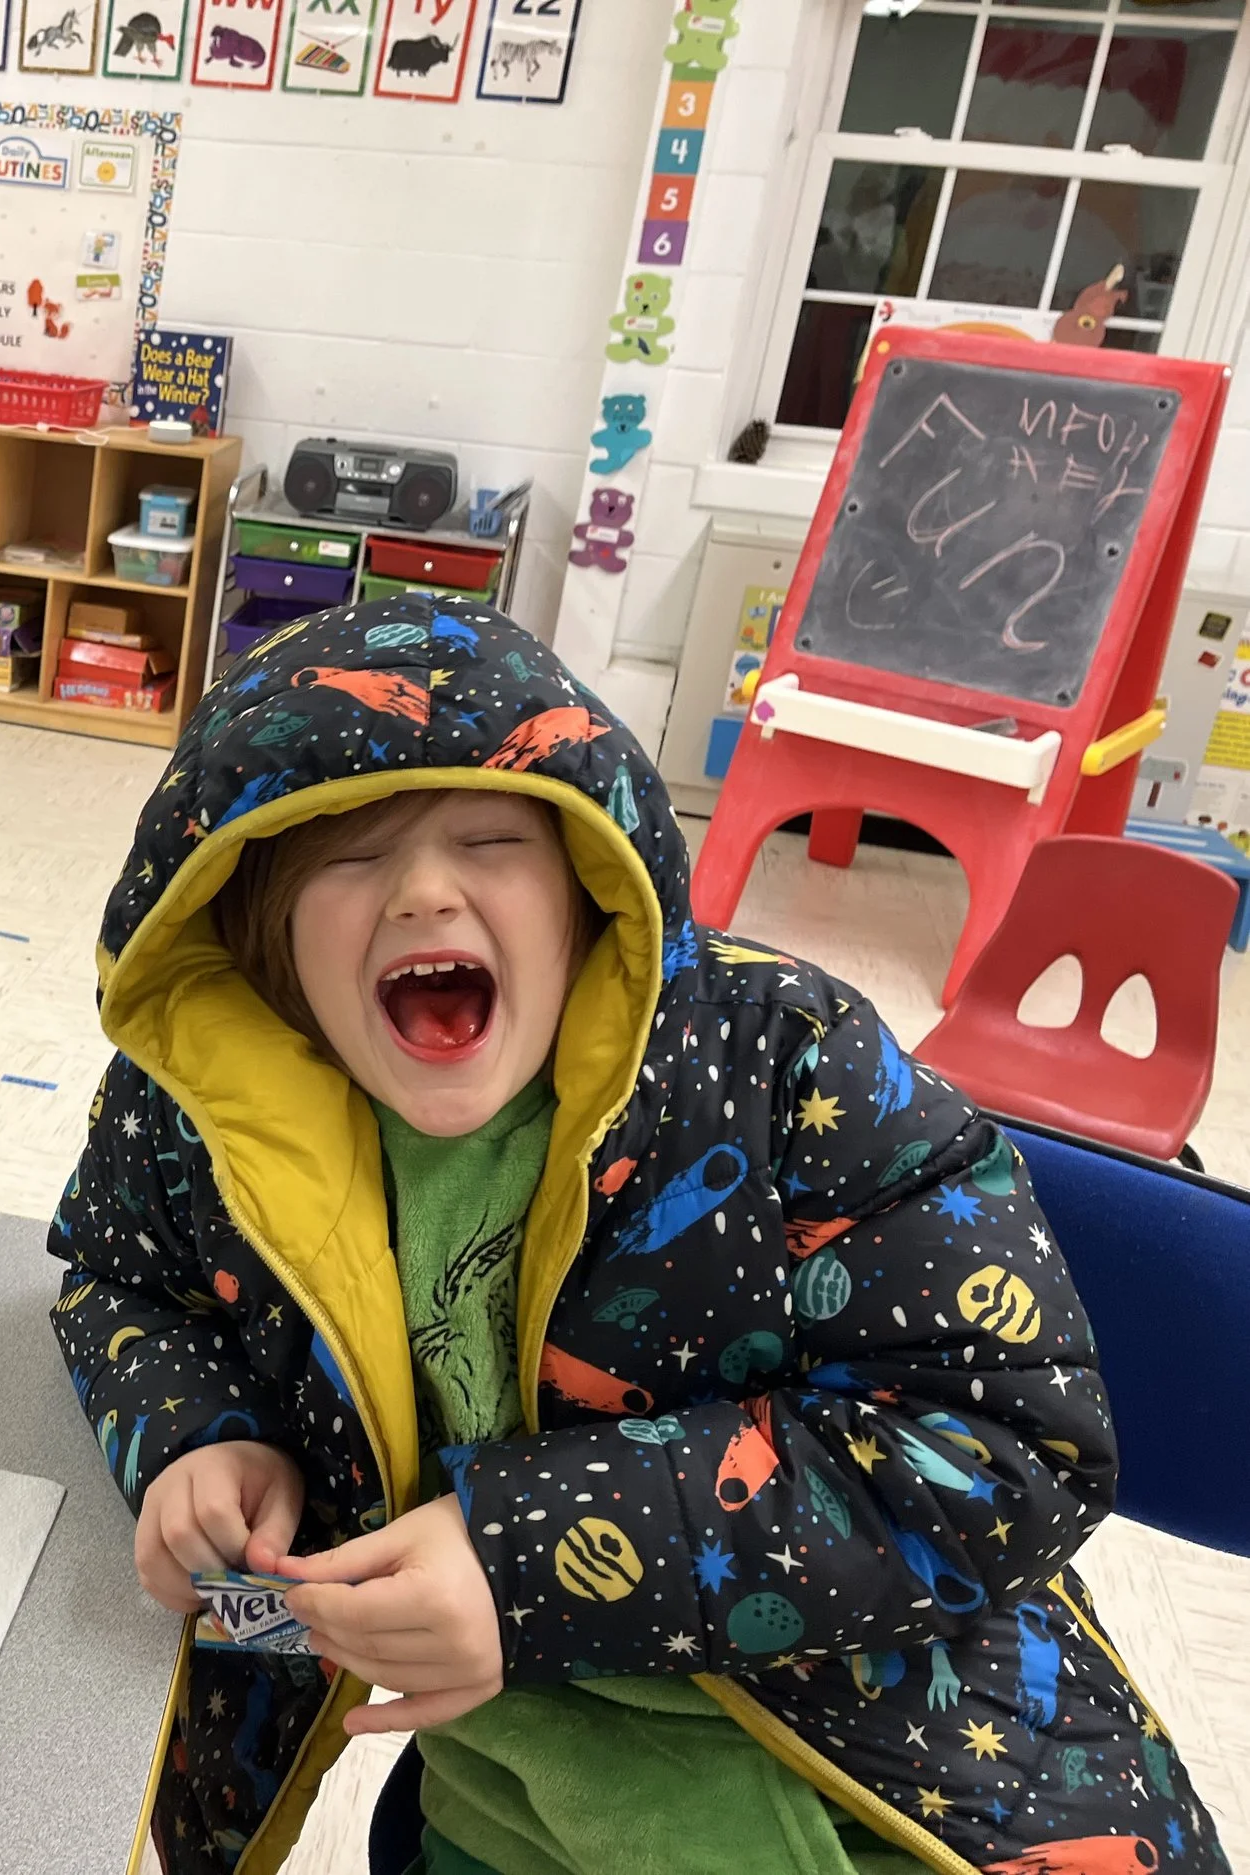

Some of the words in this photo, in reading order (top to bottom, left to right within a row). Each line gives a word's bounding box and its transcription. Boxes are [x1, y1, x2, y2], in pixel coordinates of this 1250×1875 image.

[678, 91, 696, 117] 3
[2, 146, 30, 158] Daily
[670, 138, 688, 164] 4
[660, 187, 678, 212] 5
[652, 232, 672, 256] 6
[141, 343, 172, 365] Does
[174, 352, 183, 366] a
[185, 348, 215, 368] Bear
[142, 363, 175, 383] Wear
[177, 371, 185, 385] a
[187, 368, 210, 388] Hat
[137, 384, 144, 395] in
[144, 384, 158, 395] the
[159, 384, 210, 406] Winter?
